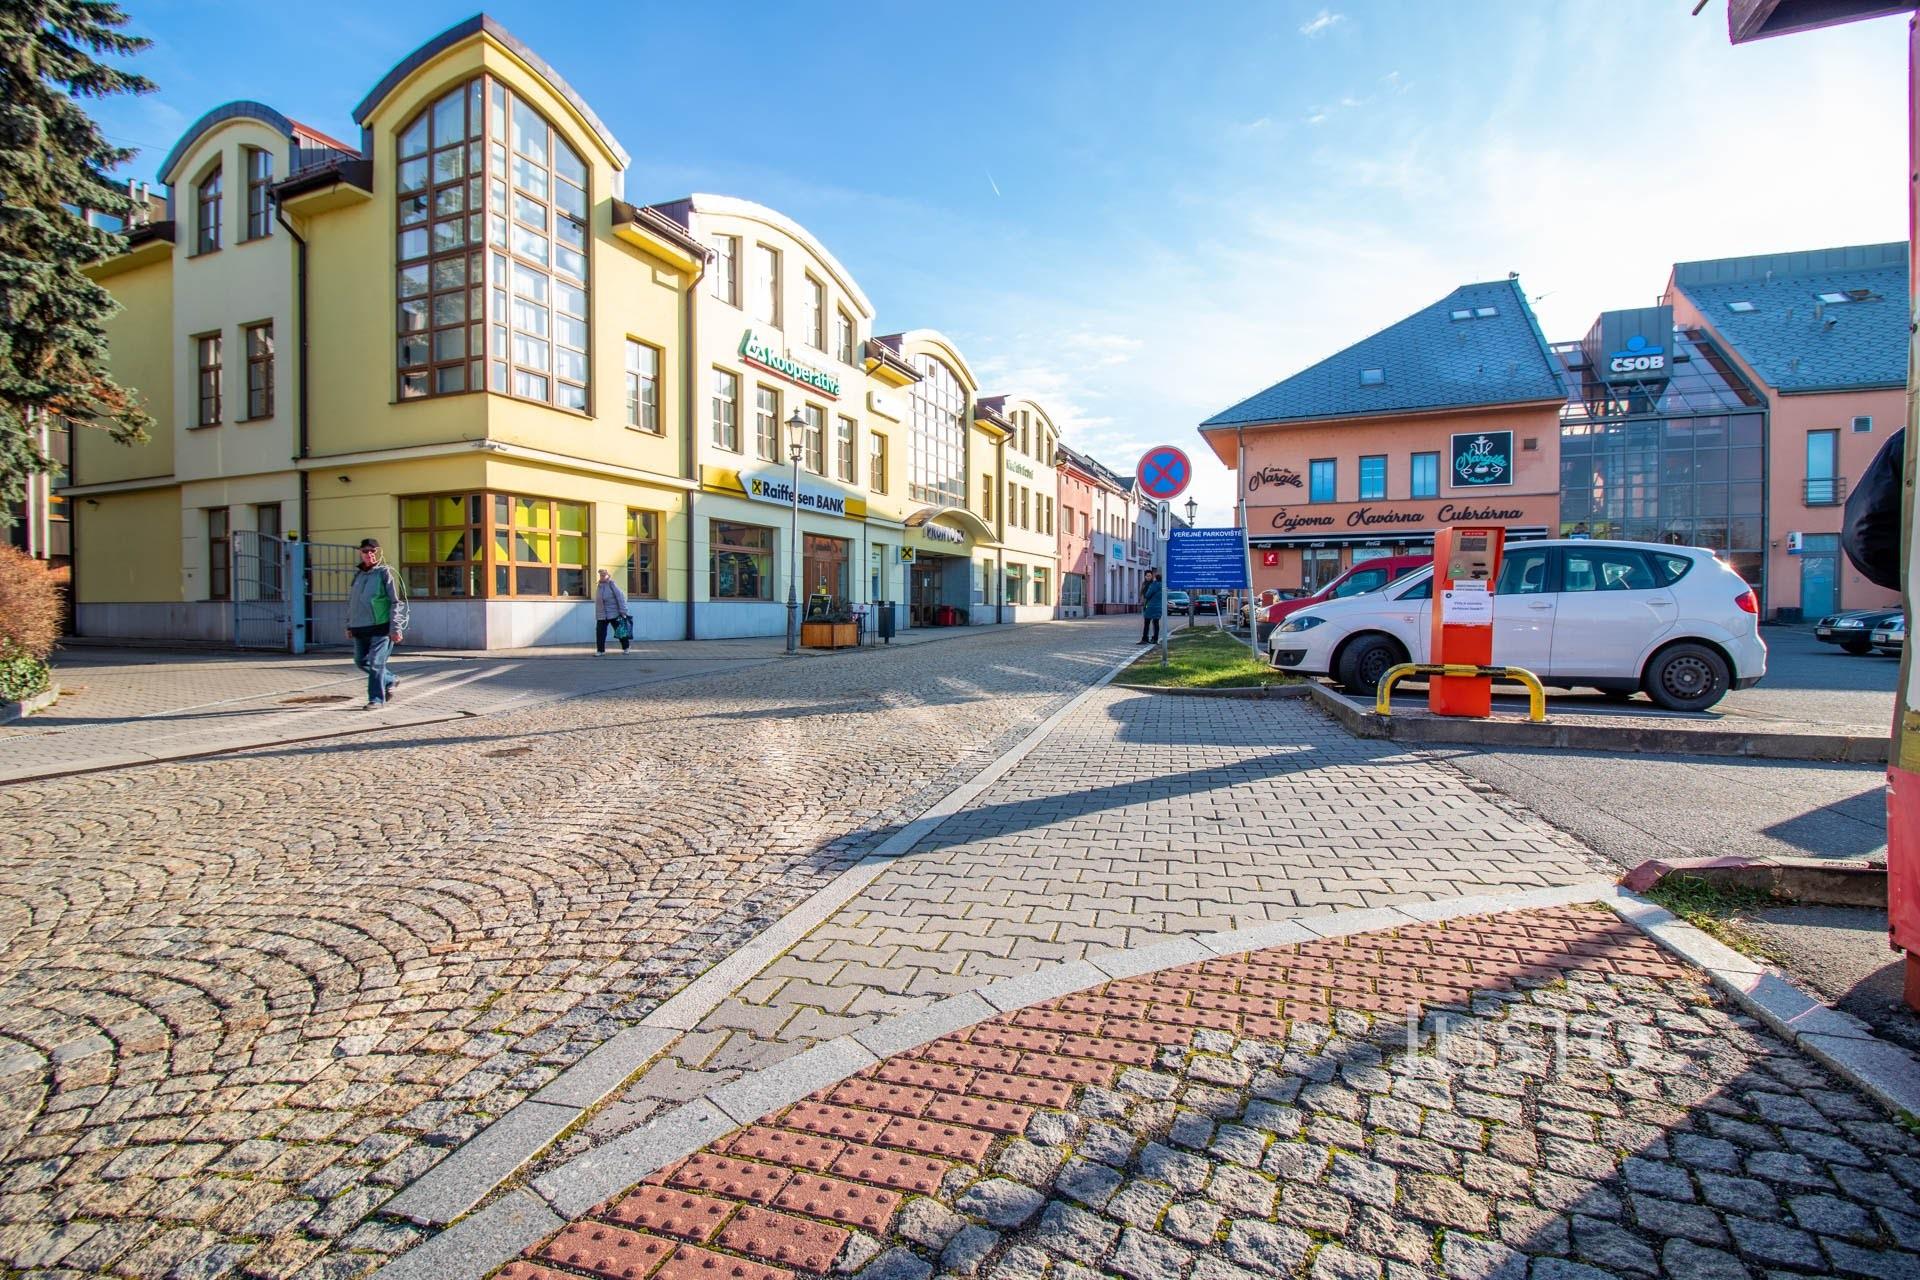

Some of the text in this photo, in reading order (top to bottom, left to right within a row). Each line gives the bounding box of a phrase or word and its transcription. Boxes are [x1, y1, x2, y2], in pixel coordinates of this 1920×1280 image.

[766, 347, 841, 396] Kooperativa
[1610, 356, 1665, 372] ČSOB
[1249, 467, 1304, 491] Nargila
[763, 481, 844, 513] Raiffesen BANK
[1272, 504, 1523, 532] Čajovna Kavárna Cukrárna
